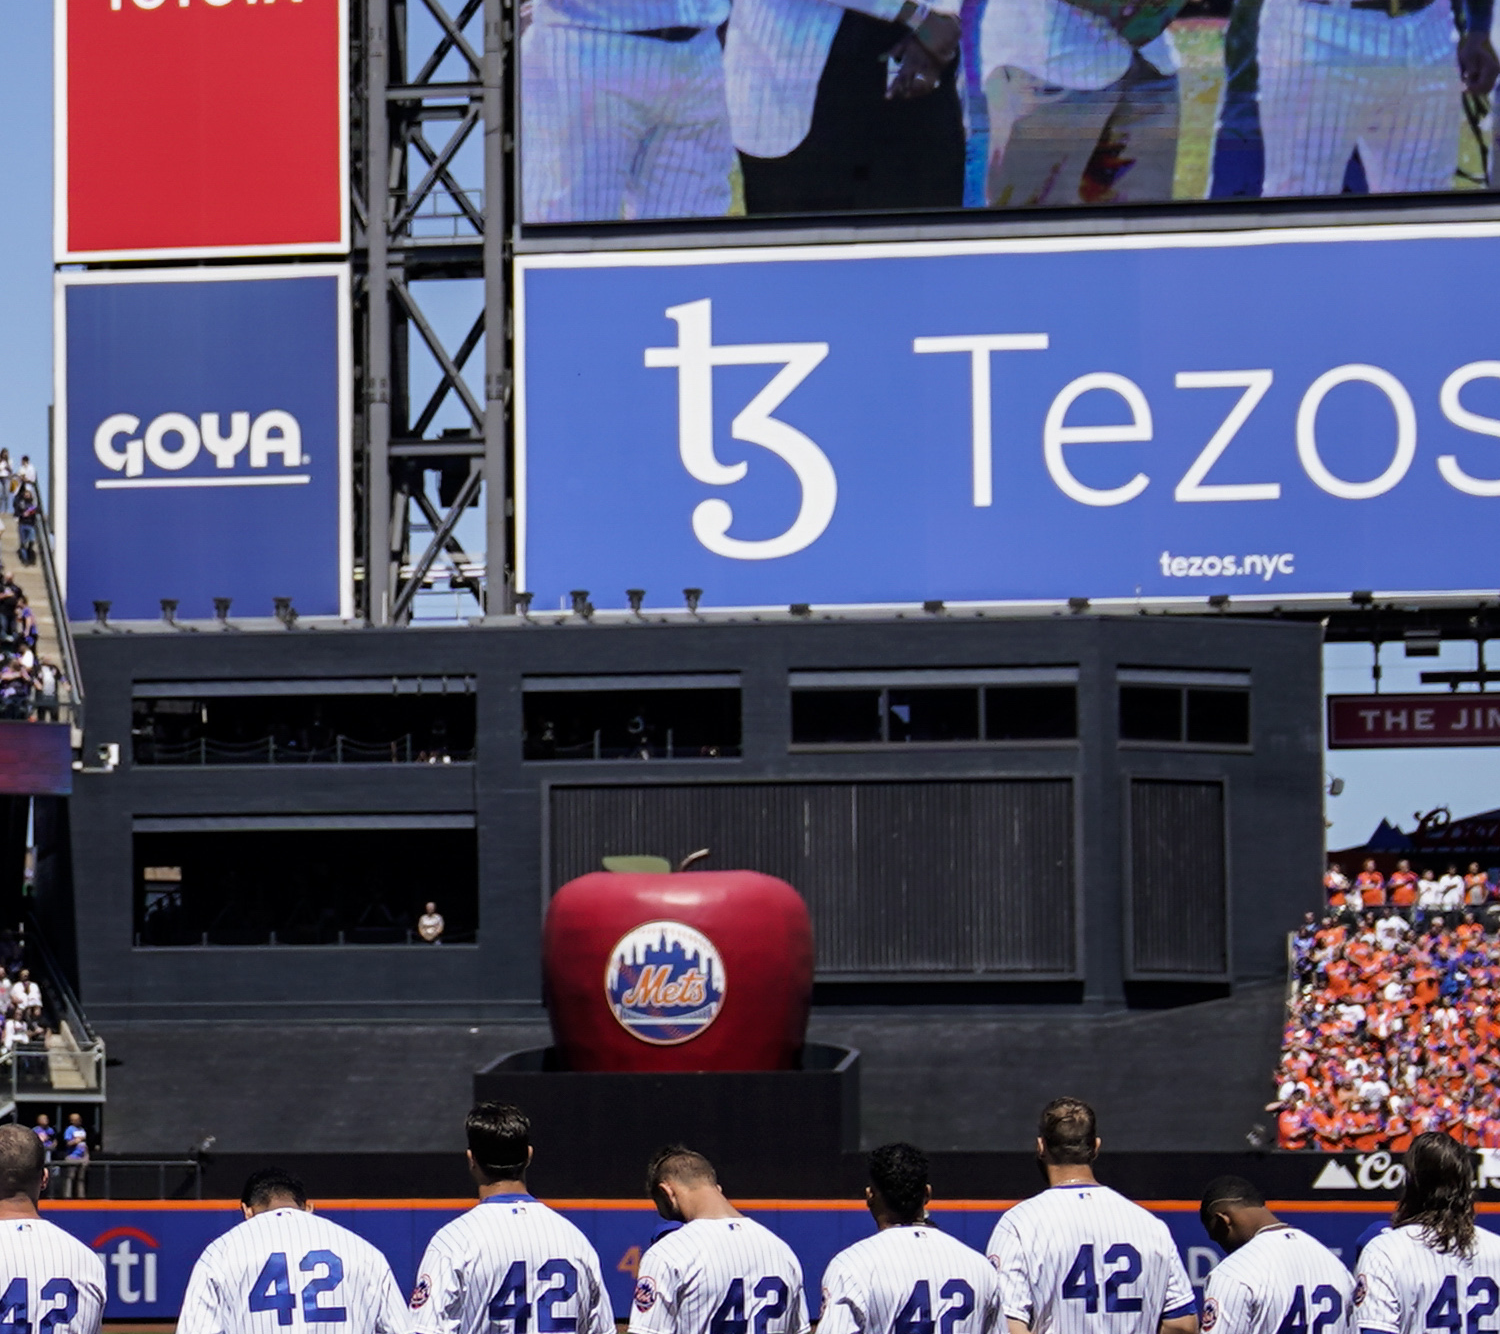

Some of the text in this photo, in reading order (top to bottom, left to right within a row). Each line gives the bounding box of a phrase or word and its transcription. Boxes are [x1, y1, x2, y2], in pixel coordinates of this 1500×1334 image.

[95, 409, 304, 476] GOYA
[1159, 549, 1295, 582] tezos.nyc
[1358, 708, 1436, 732] THE
[621, 964, 709, 1010] Mets
[249, 1249, 347, 1326] 42
[489, 1259, 577, 1334] 42
[1063, 1244, 1142, 1313] 42
